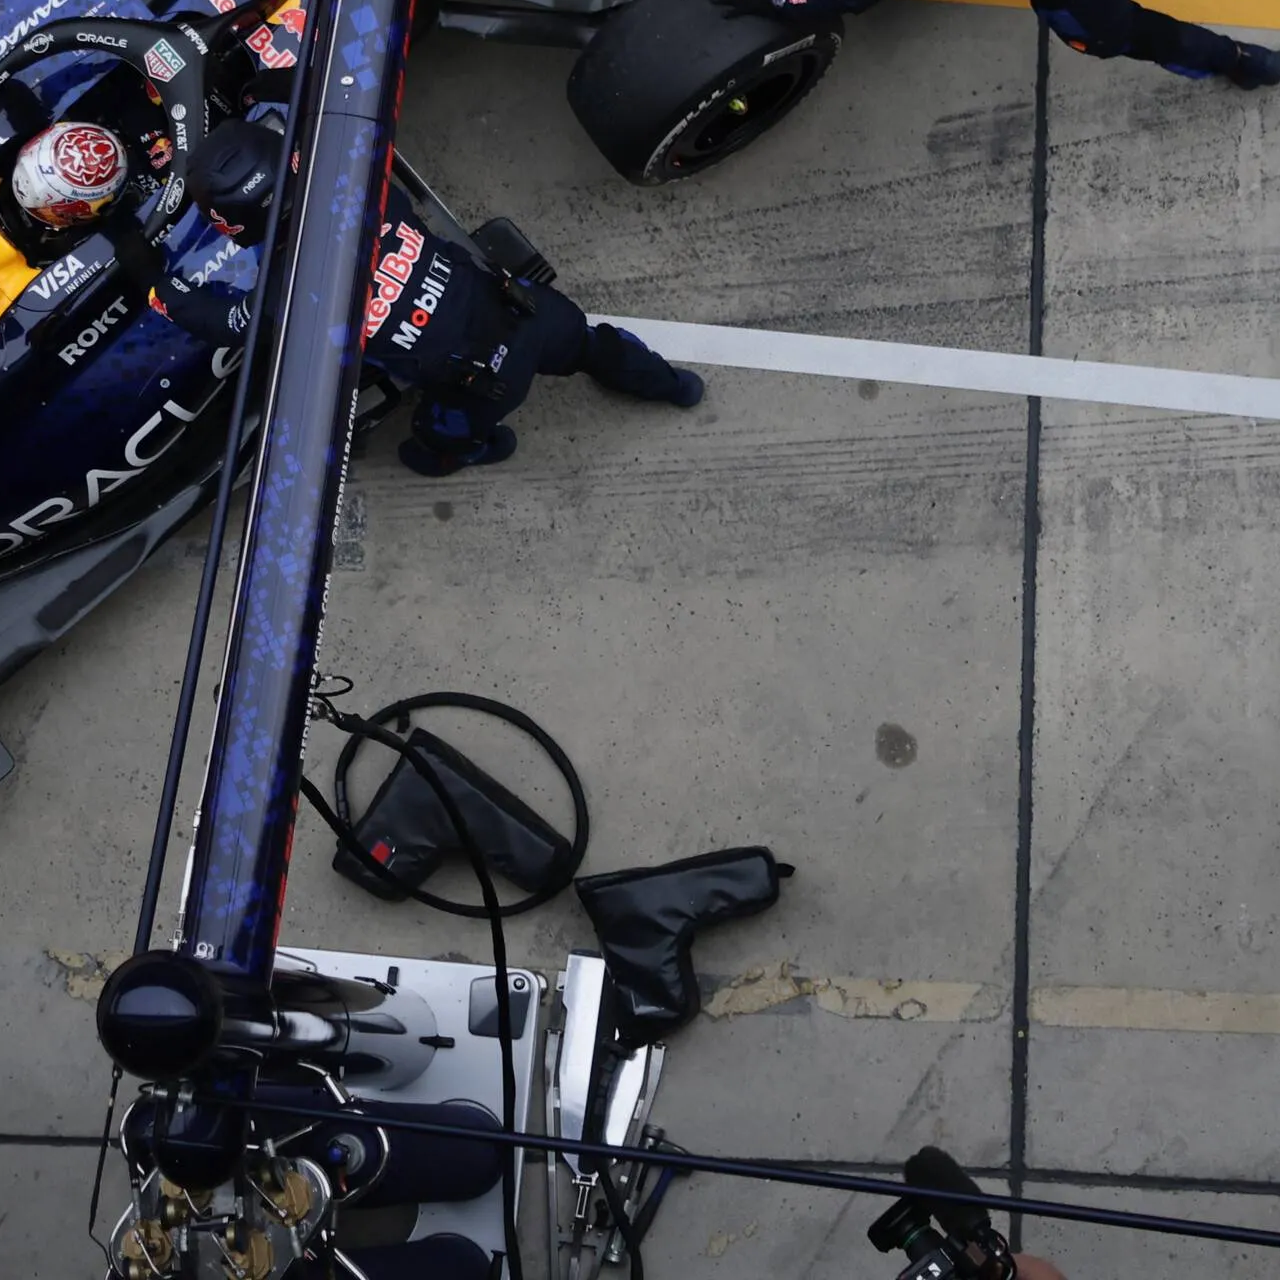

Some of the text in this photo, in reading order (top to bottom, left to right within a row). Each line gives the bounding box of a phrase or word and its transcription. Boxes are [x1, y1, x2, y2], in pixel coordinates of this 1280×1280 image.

[76, 32, 128, 48] ORACLE
[184, 28, 208, 55] Mobil
[146, 50, 174, 78] HEUER
[158, 43, 181, 72] TAG
[175, 122, 188, 151] AT&T
[71, 188, 105, 197] Heineken
[379, 221, 425, 284] Bull
[28, 255, 85, 300] VISA
[65, 261, 102, 294] INFINITE
[391, 276, 445, 350] Mobil
[58, 296, 129, 366] ROKT
